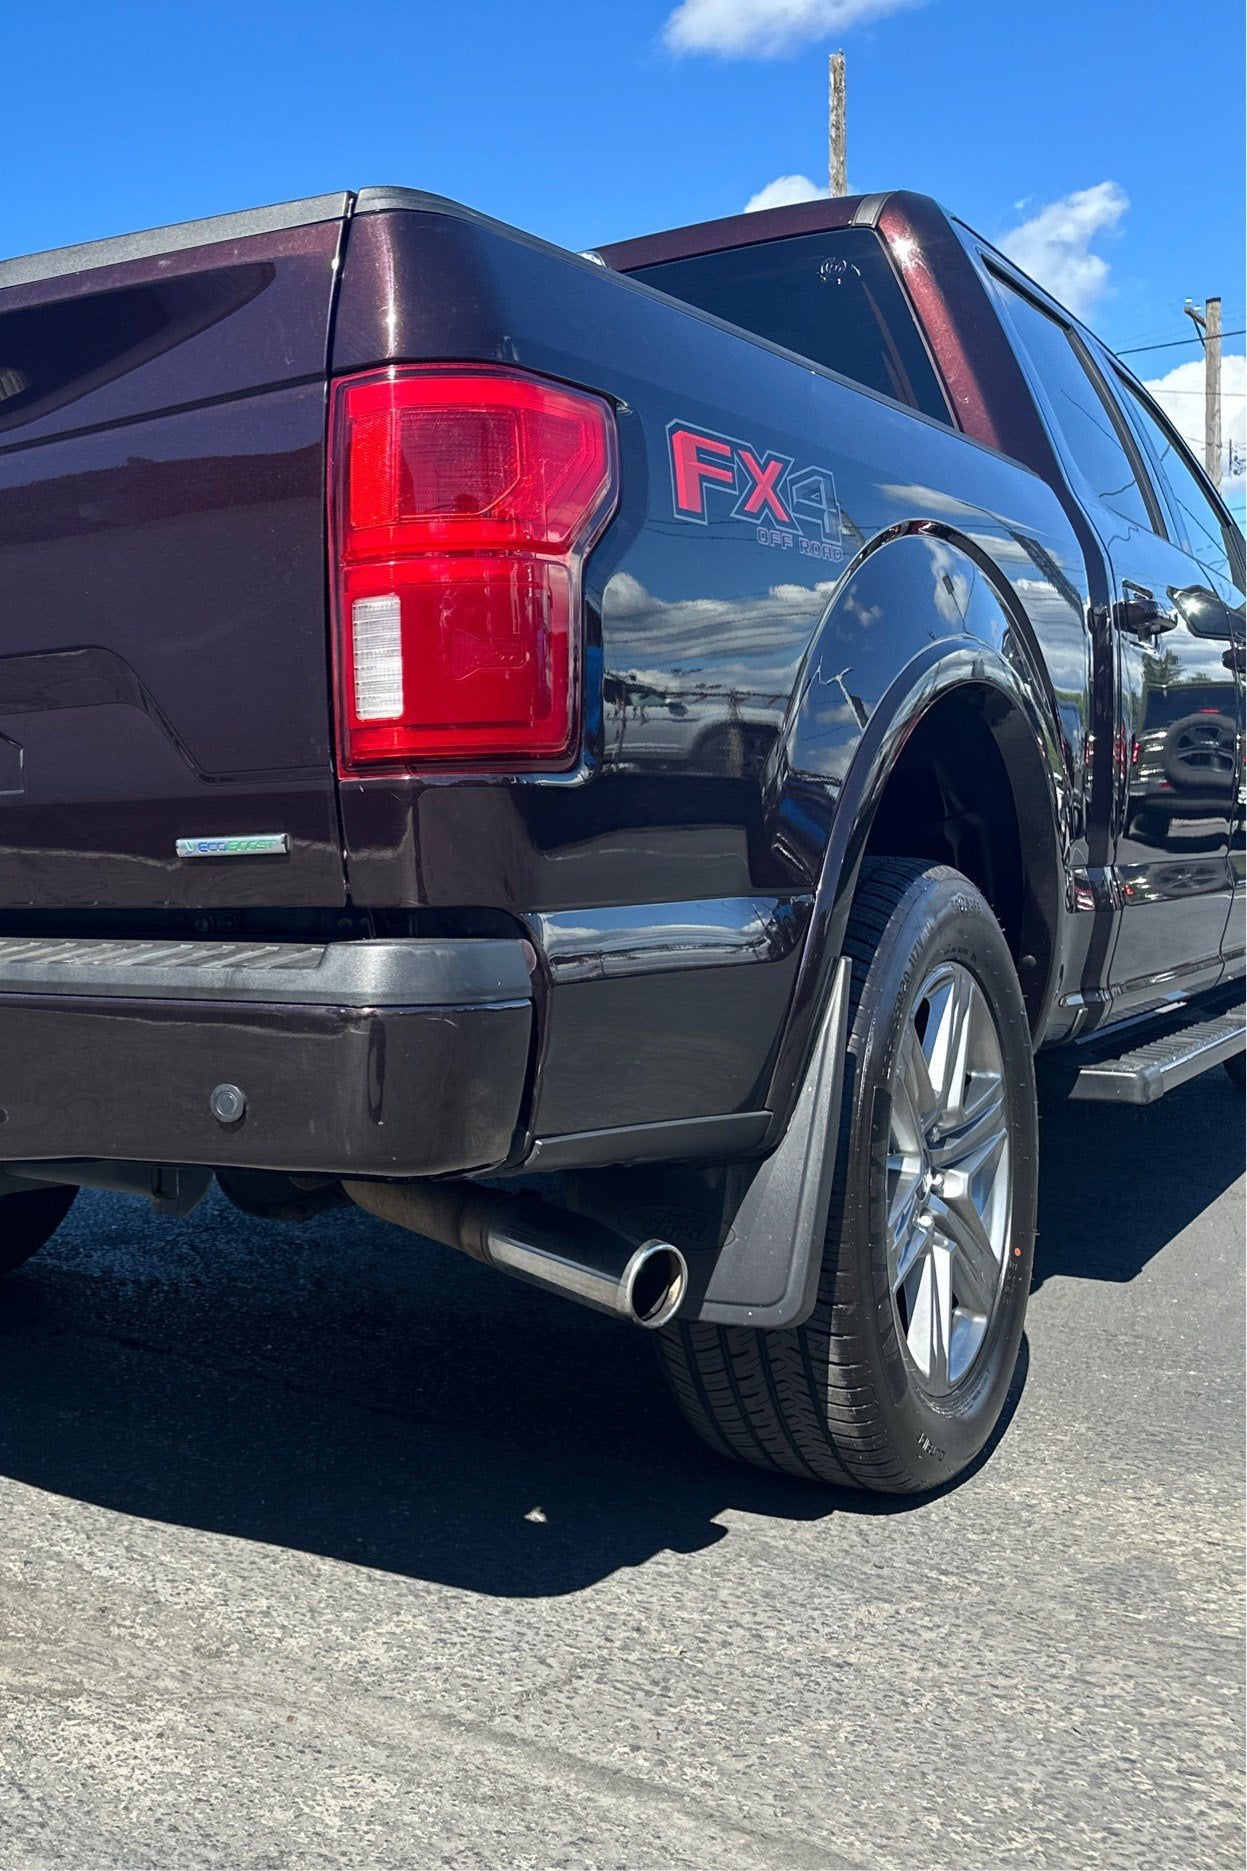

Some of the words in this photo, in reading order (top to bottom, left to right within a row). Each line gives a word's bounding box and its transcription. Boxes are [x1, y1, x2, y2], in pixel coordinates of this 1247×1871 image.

[665, 418, 843, 545] FX4
[756, 526, 794, 549] OFF
[798, 537, 844, 562] ROAD
